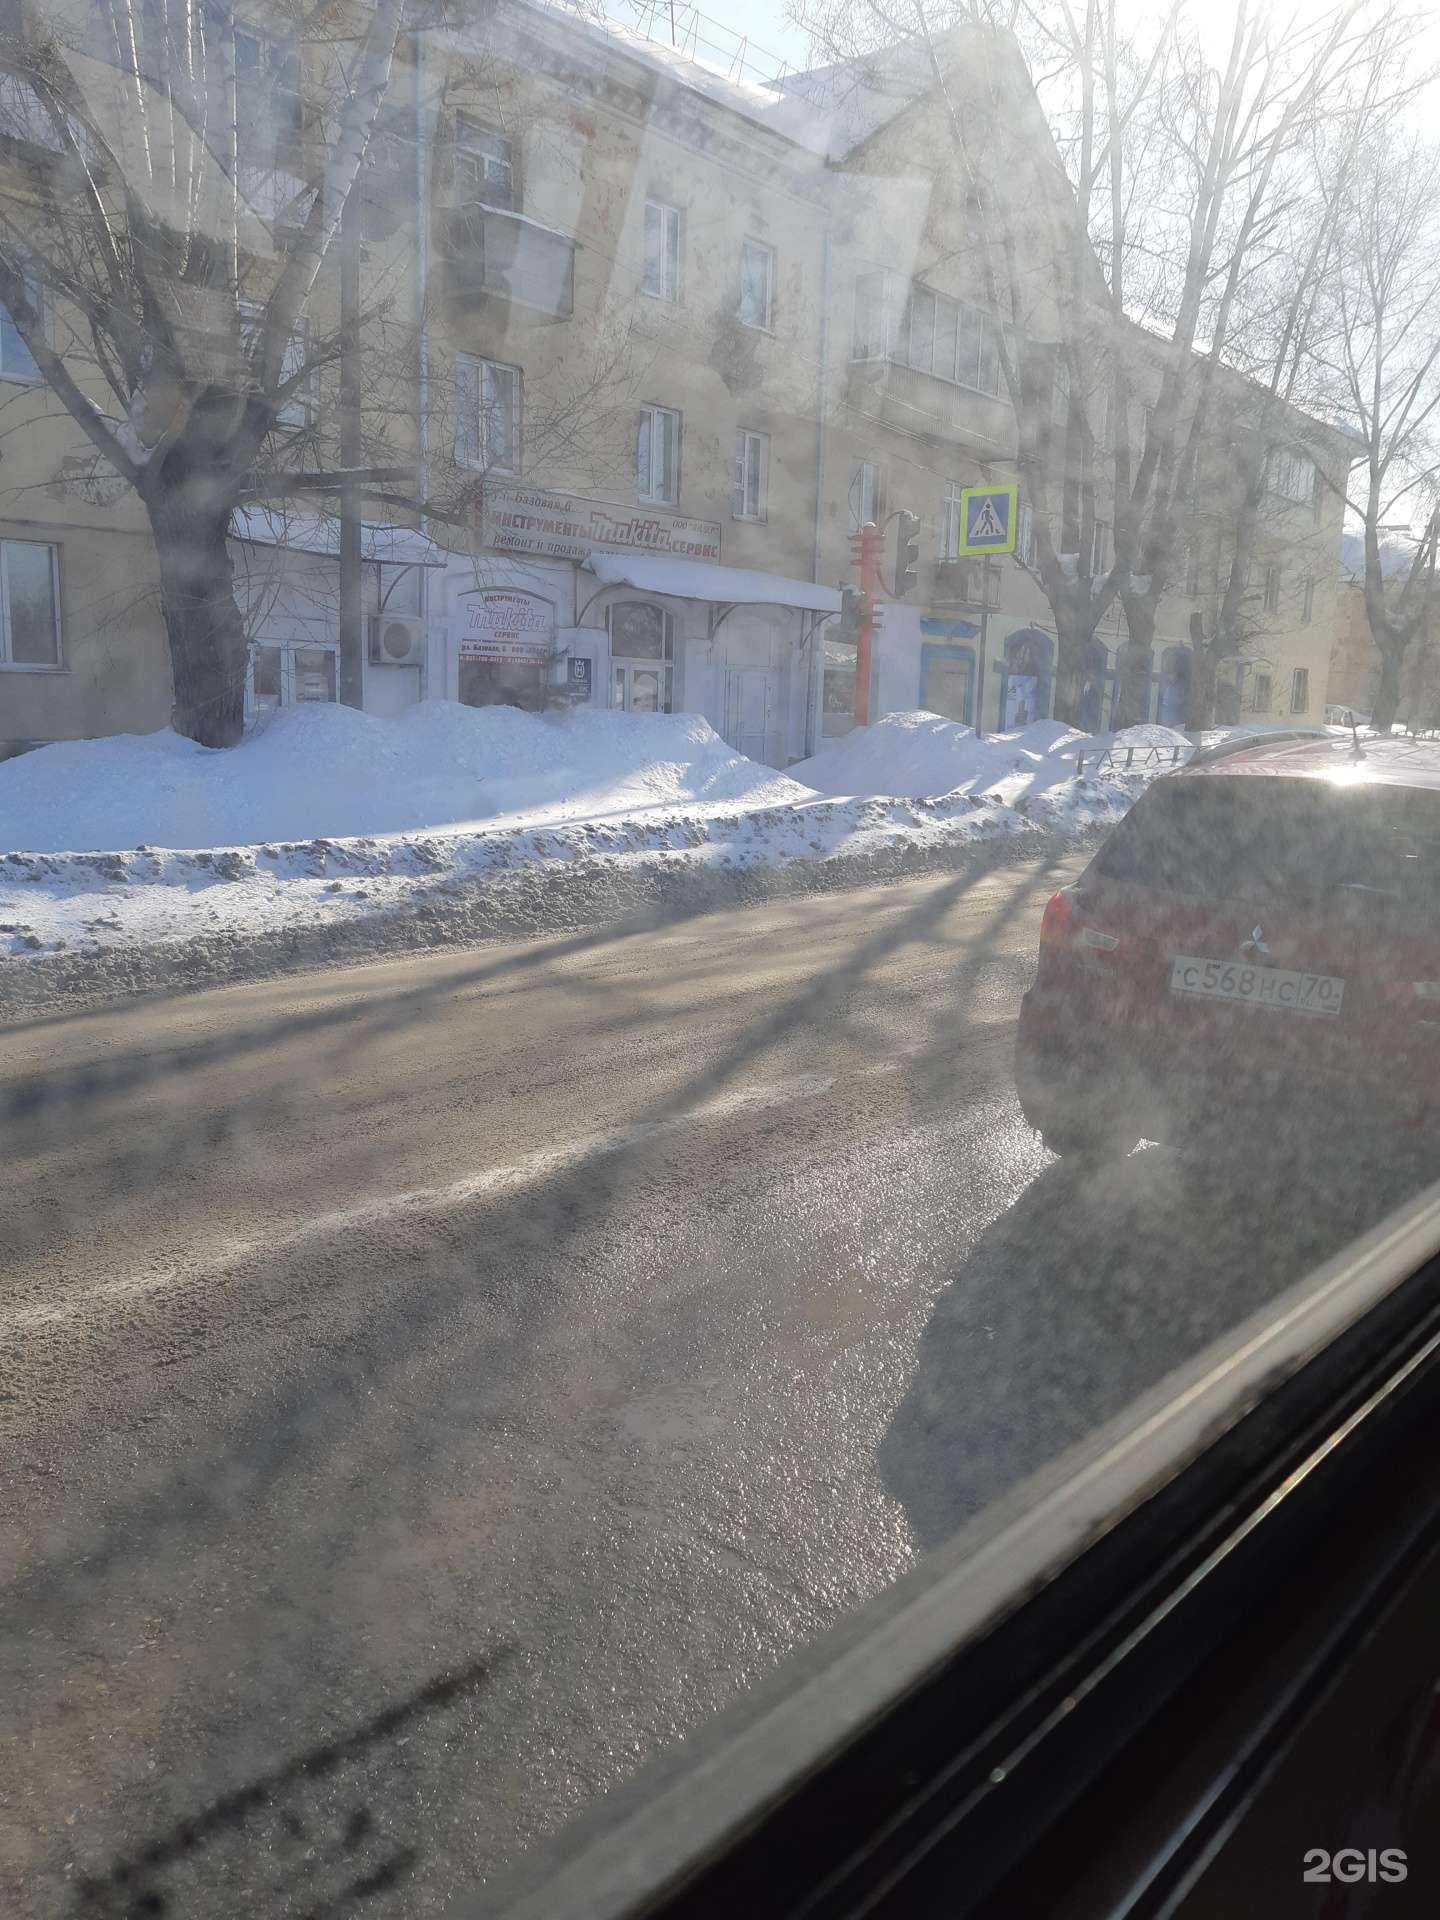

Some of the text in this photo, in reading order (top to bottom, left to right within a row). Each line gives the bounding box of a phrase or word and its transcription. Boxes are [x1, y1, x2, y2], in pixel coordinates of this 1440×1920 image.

[496, 511, 591, 537] ИНСТРУМЕНТЫ
[590, 511, 672, 553] Makita
[493, 534, 532, 549] ремонт
